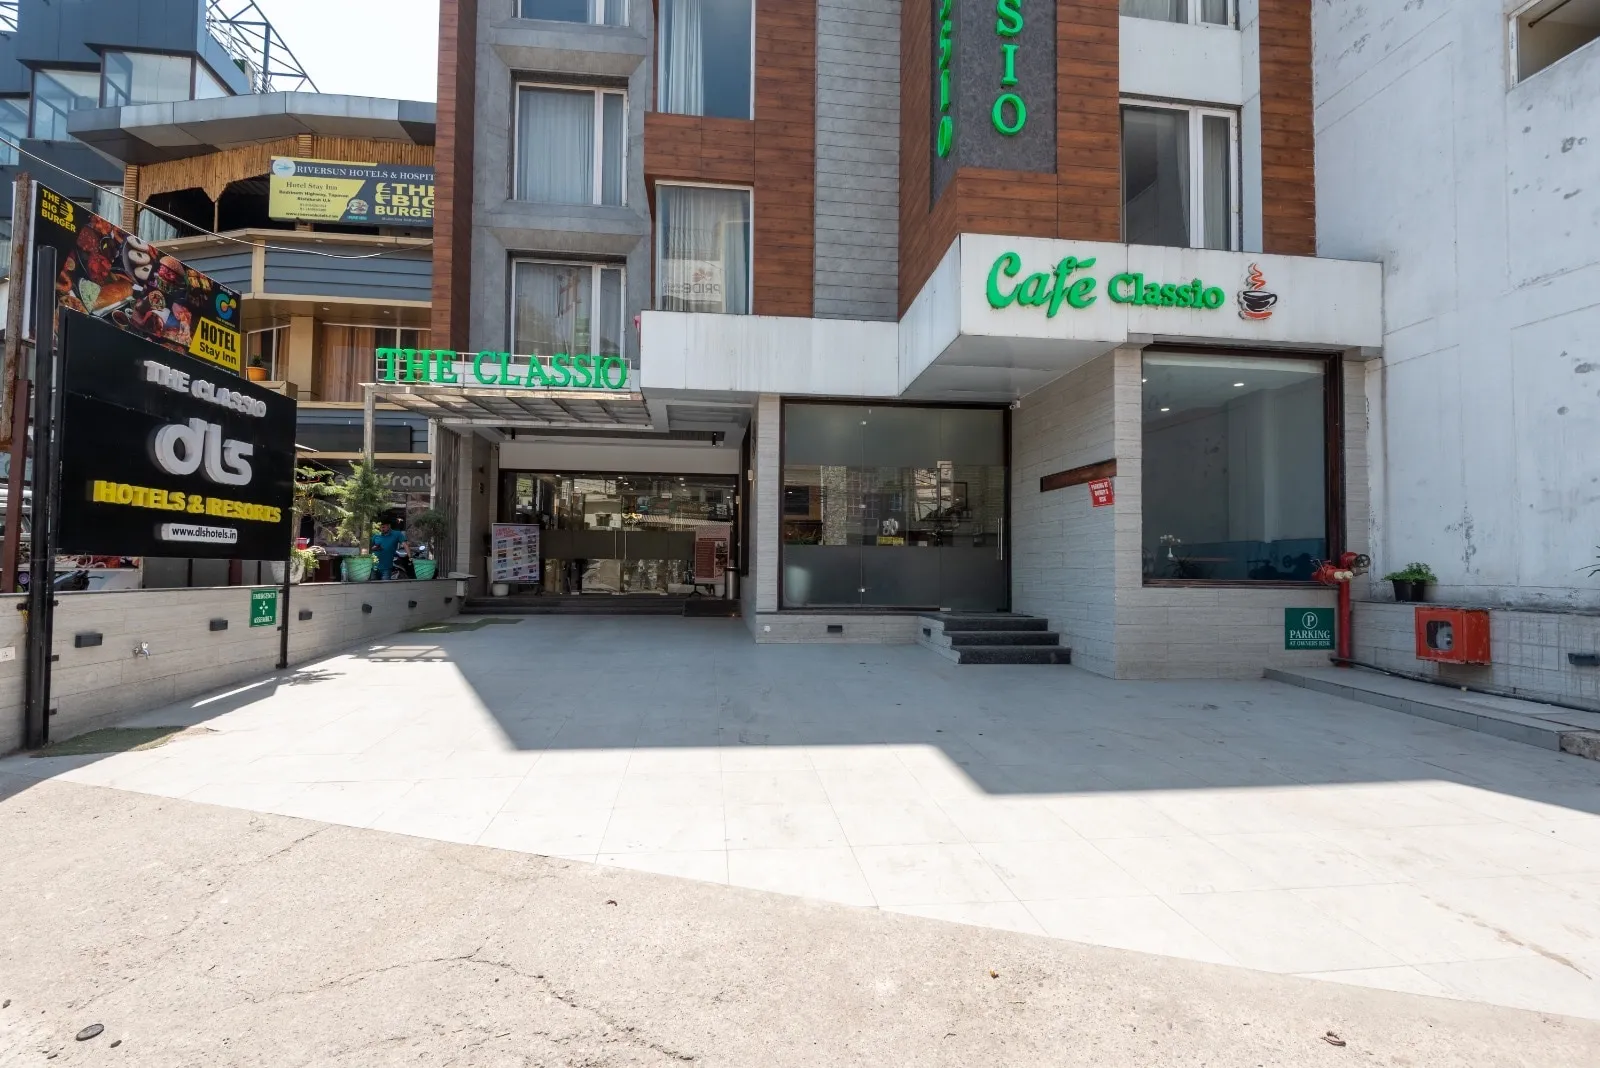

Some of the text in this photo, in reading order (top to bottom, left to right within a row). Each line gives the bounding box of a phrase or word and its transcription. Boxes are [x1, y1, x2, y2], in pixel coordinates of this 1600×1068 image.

[297, 165, 347, 176] RIVERSUN
[350, 169, 388, 179] HOTELS
[390, 171, 398, 179] &
[42, 188, 60, 205] THE
[286, 181, 306, 189] Hotel
[308, 183, 323, 191] Stay
[42, 199, 58, 214] BIG
[41, 208, 76, 233] BURGER
[986, 251, 1225, 319] Café Classio
[200, 320, 236, 353] HOTEL
[199, 341, 237, 365] Stay Inn
[377, 347, 628, 390] THE CLASSIO
[143, 360, 267, 418] THE CLASSIO
[154, 417, 254, 486] dls
[93, 480, 282, 523] HOTELS & RESORTS
[171, 526, 237, 541] www.dlshotels.in
[1289, 629, 1331, 639] PARKING
